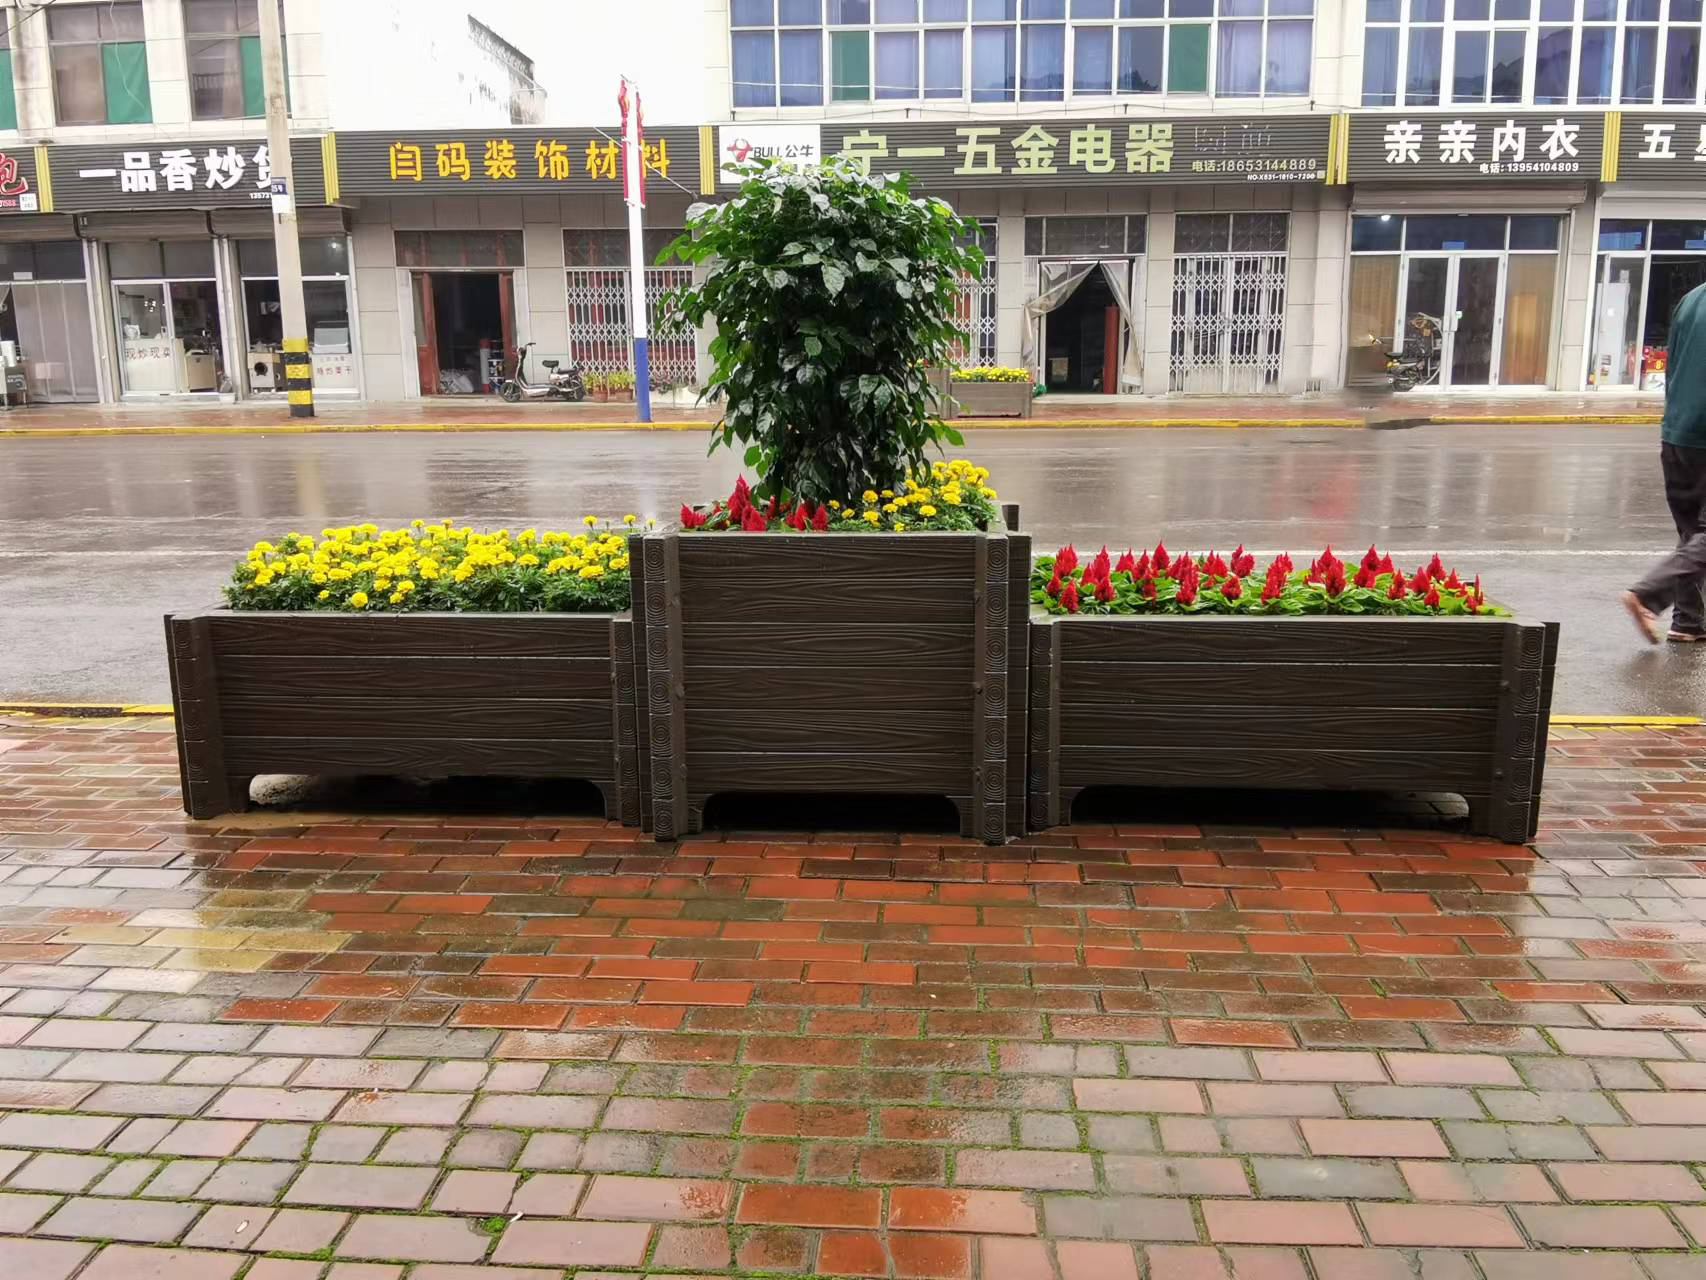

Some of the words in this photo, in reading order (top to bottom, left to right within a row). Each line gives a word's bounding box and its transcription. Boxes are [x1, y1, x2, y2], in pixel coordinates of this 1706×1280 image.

[389, 139, 671, 181] 闫码装饰材料
[785, 144, 814, 158] 公牛
[842, 123, 1174, 176] 宁一五金电器
[1383, 118, 1580, 164] 亲亲内衣
